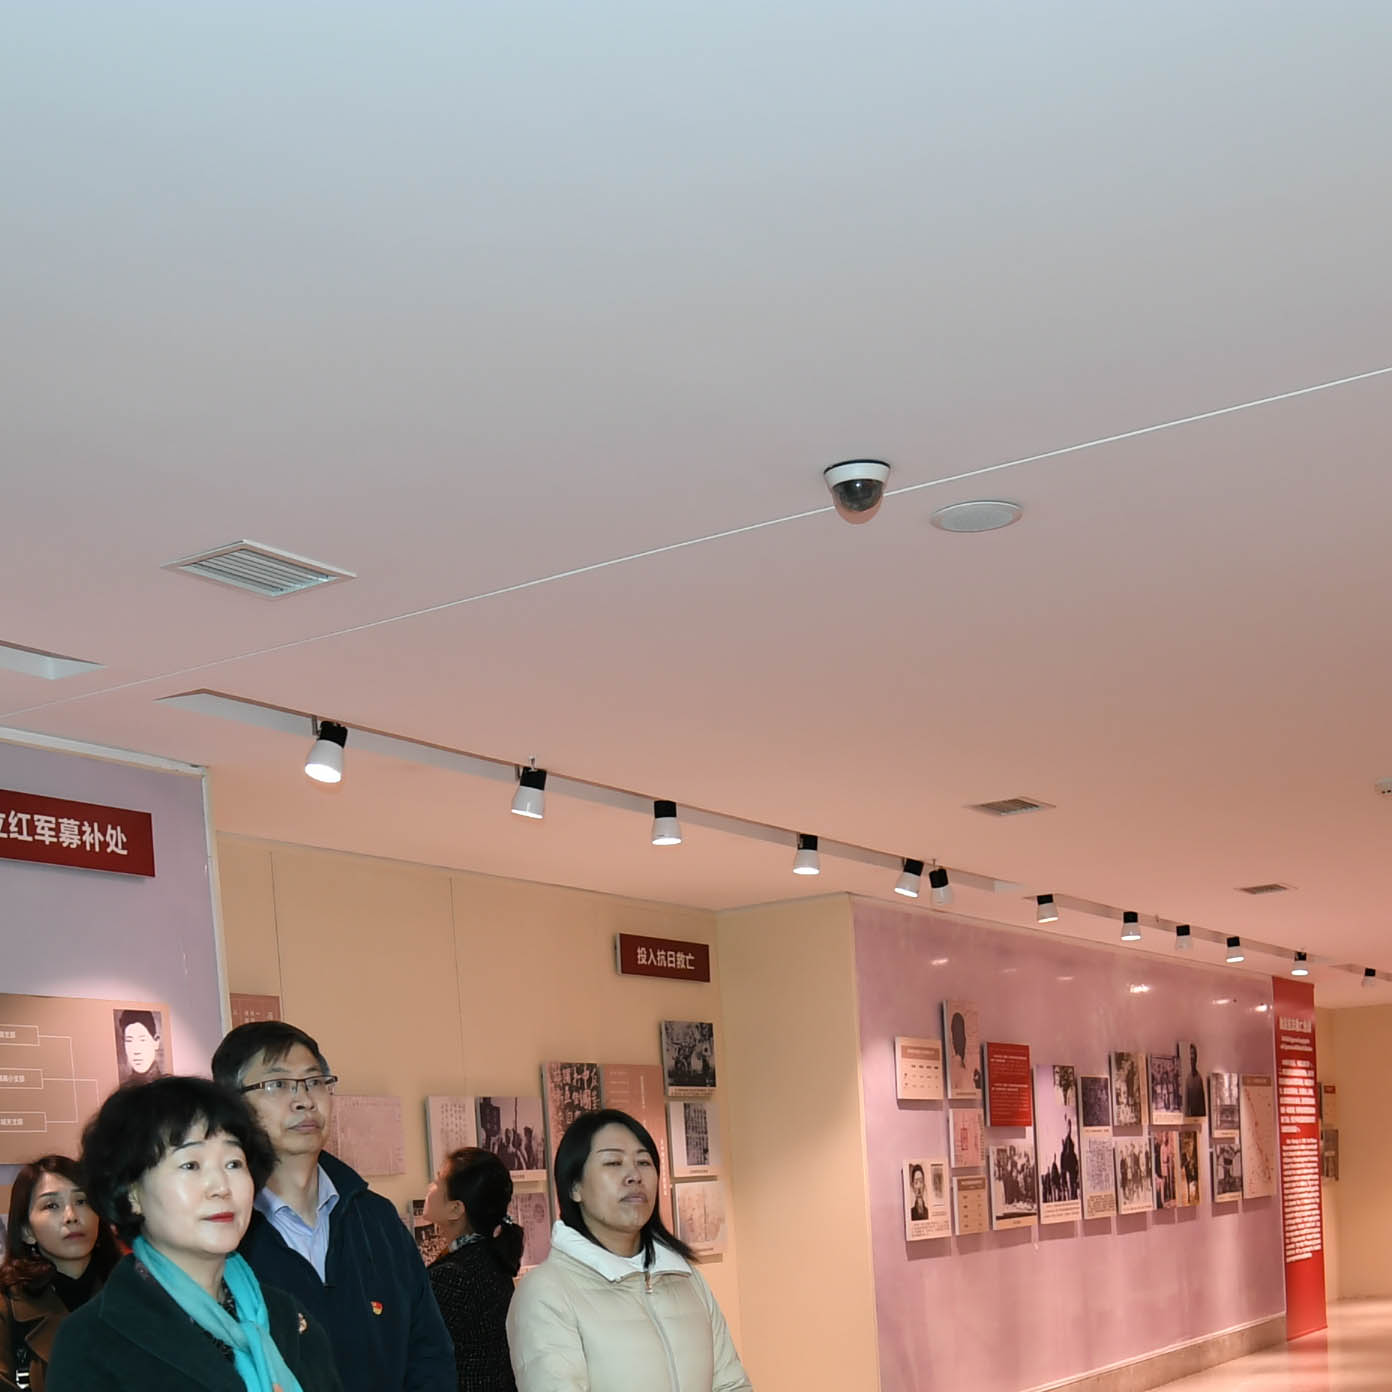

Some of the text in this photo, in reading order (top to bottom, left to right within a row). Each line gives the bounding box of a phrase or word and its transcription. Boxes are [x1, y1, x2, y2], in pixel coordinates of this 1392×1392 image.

[637, 946, 695, 970] 投入抗日救亡
